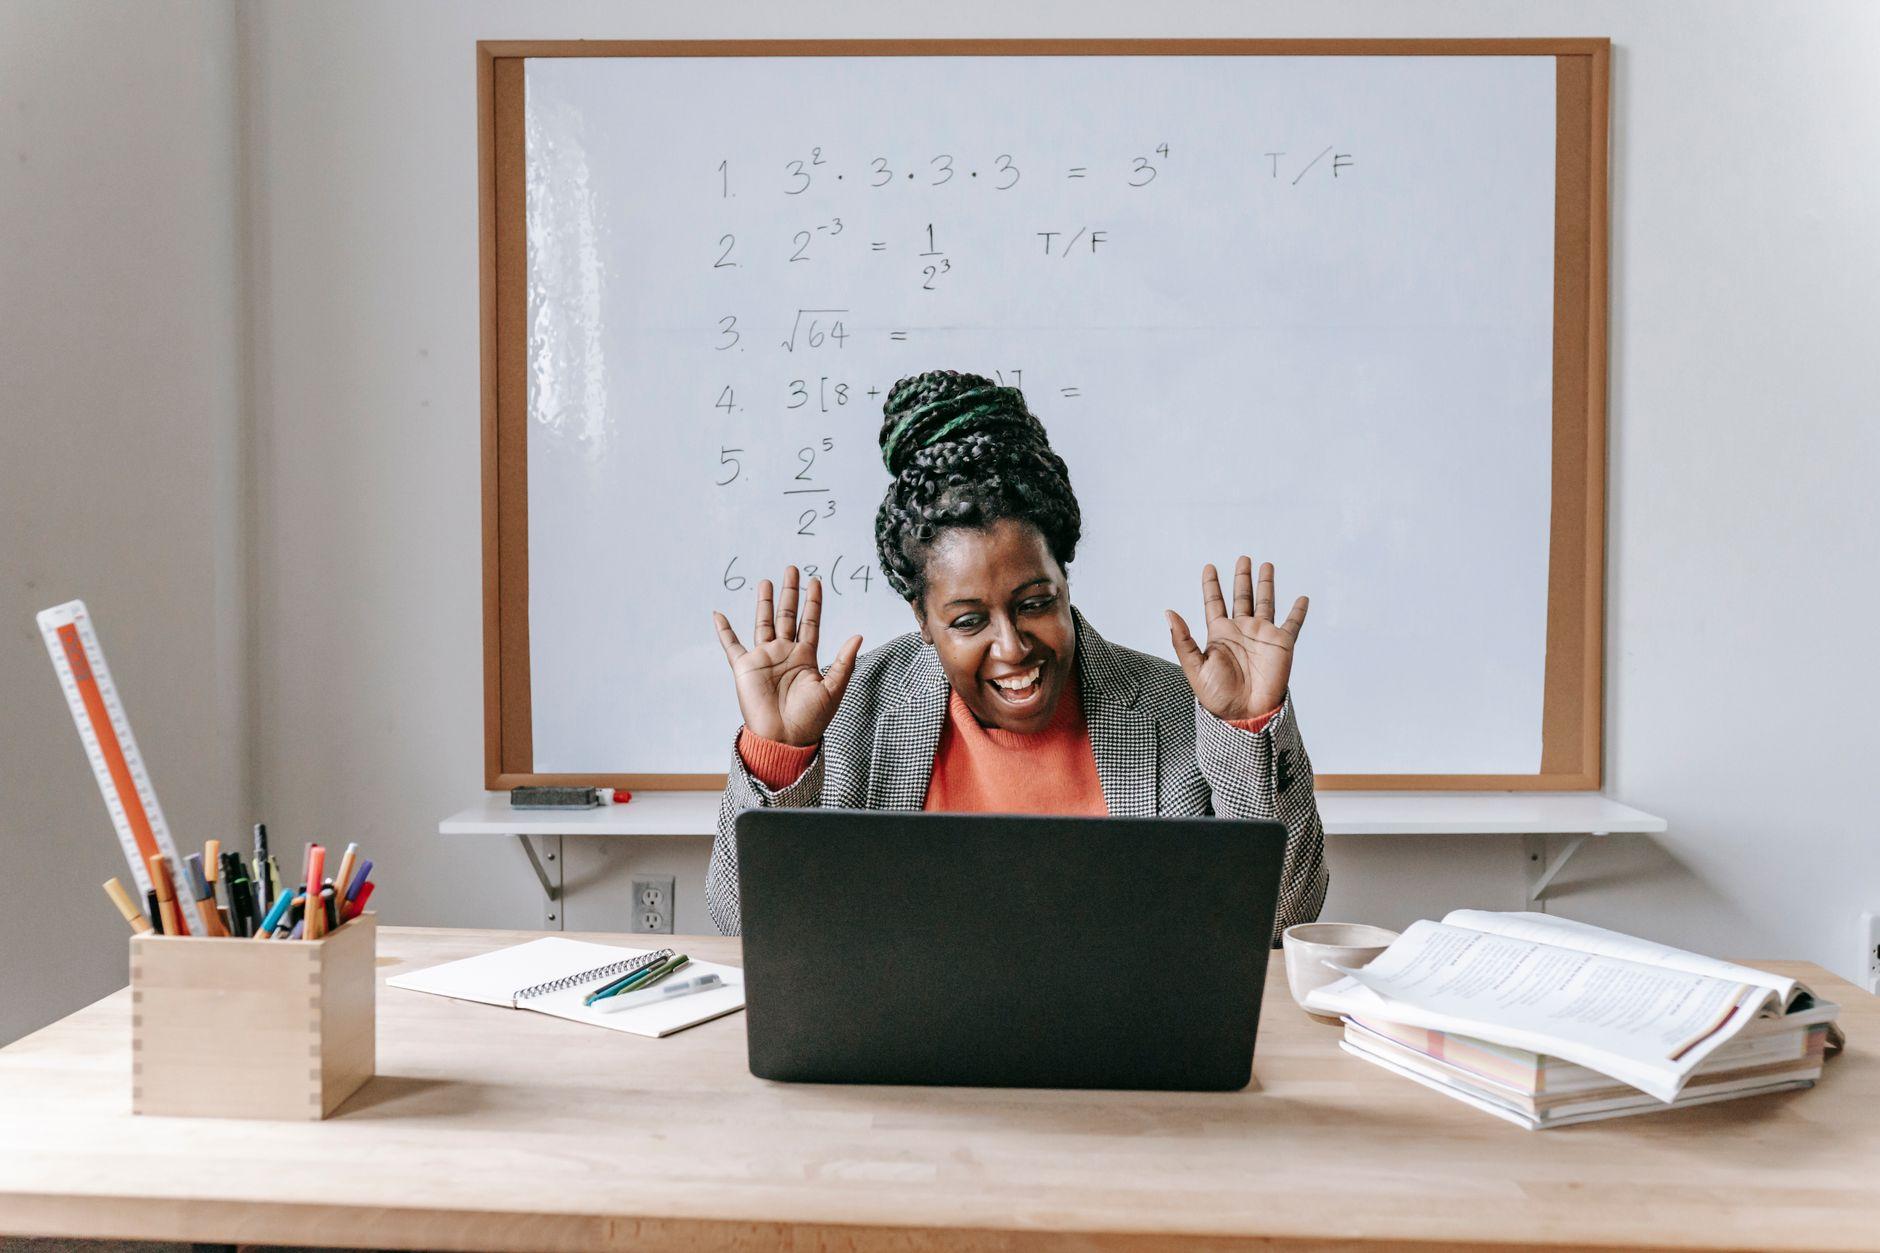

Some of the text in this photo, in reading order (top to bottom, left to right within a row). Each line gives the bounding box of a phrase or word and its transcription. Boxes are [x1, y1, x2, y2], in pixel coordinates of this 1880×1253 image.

[717, 159, 736, 199] 1.
[870, 156, 894, 188] 3
[929, 154, 954, 187] 3
[994, 153, 1021, 191] 3
[713, 233, 743, 269] 2.
[714, 315, 745, 353] 3.
[714, 384, 744, 415] 4.
[715, 445, 750, 487] 5.
[723, 555, 754, 592] 6.
